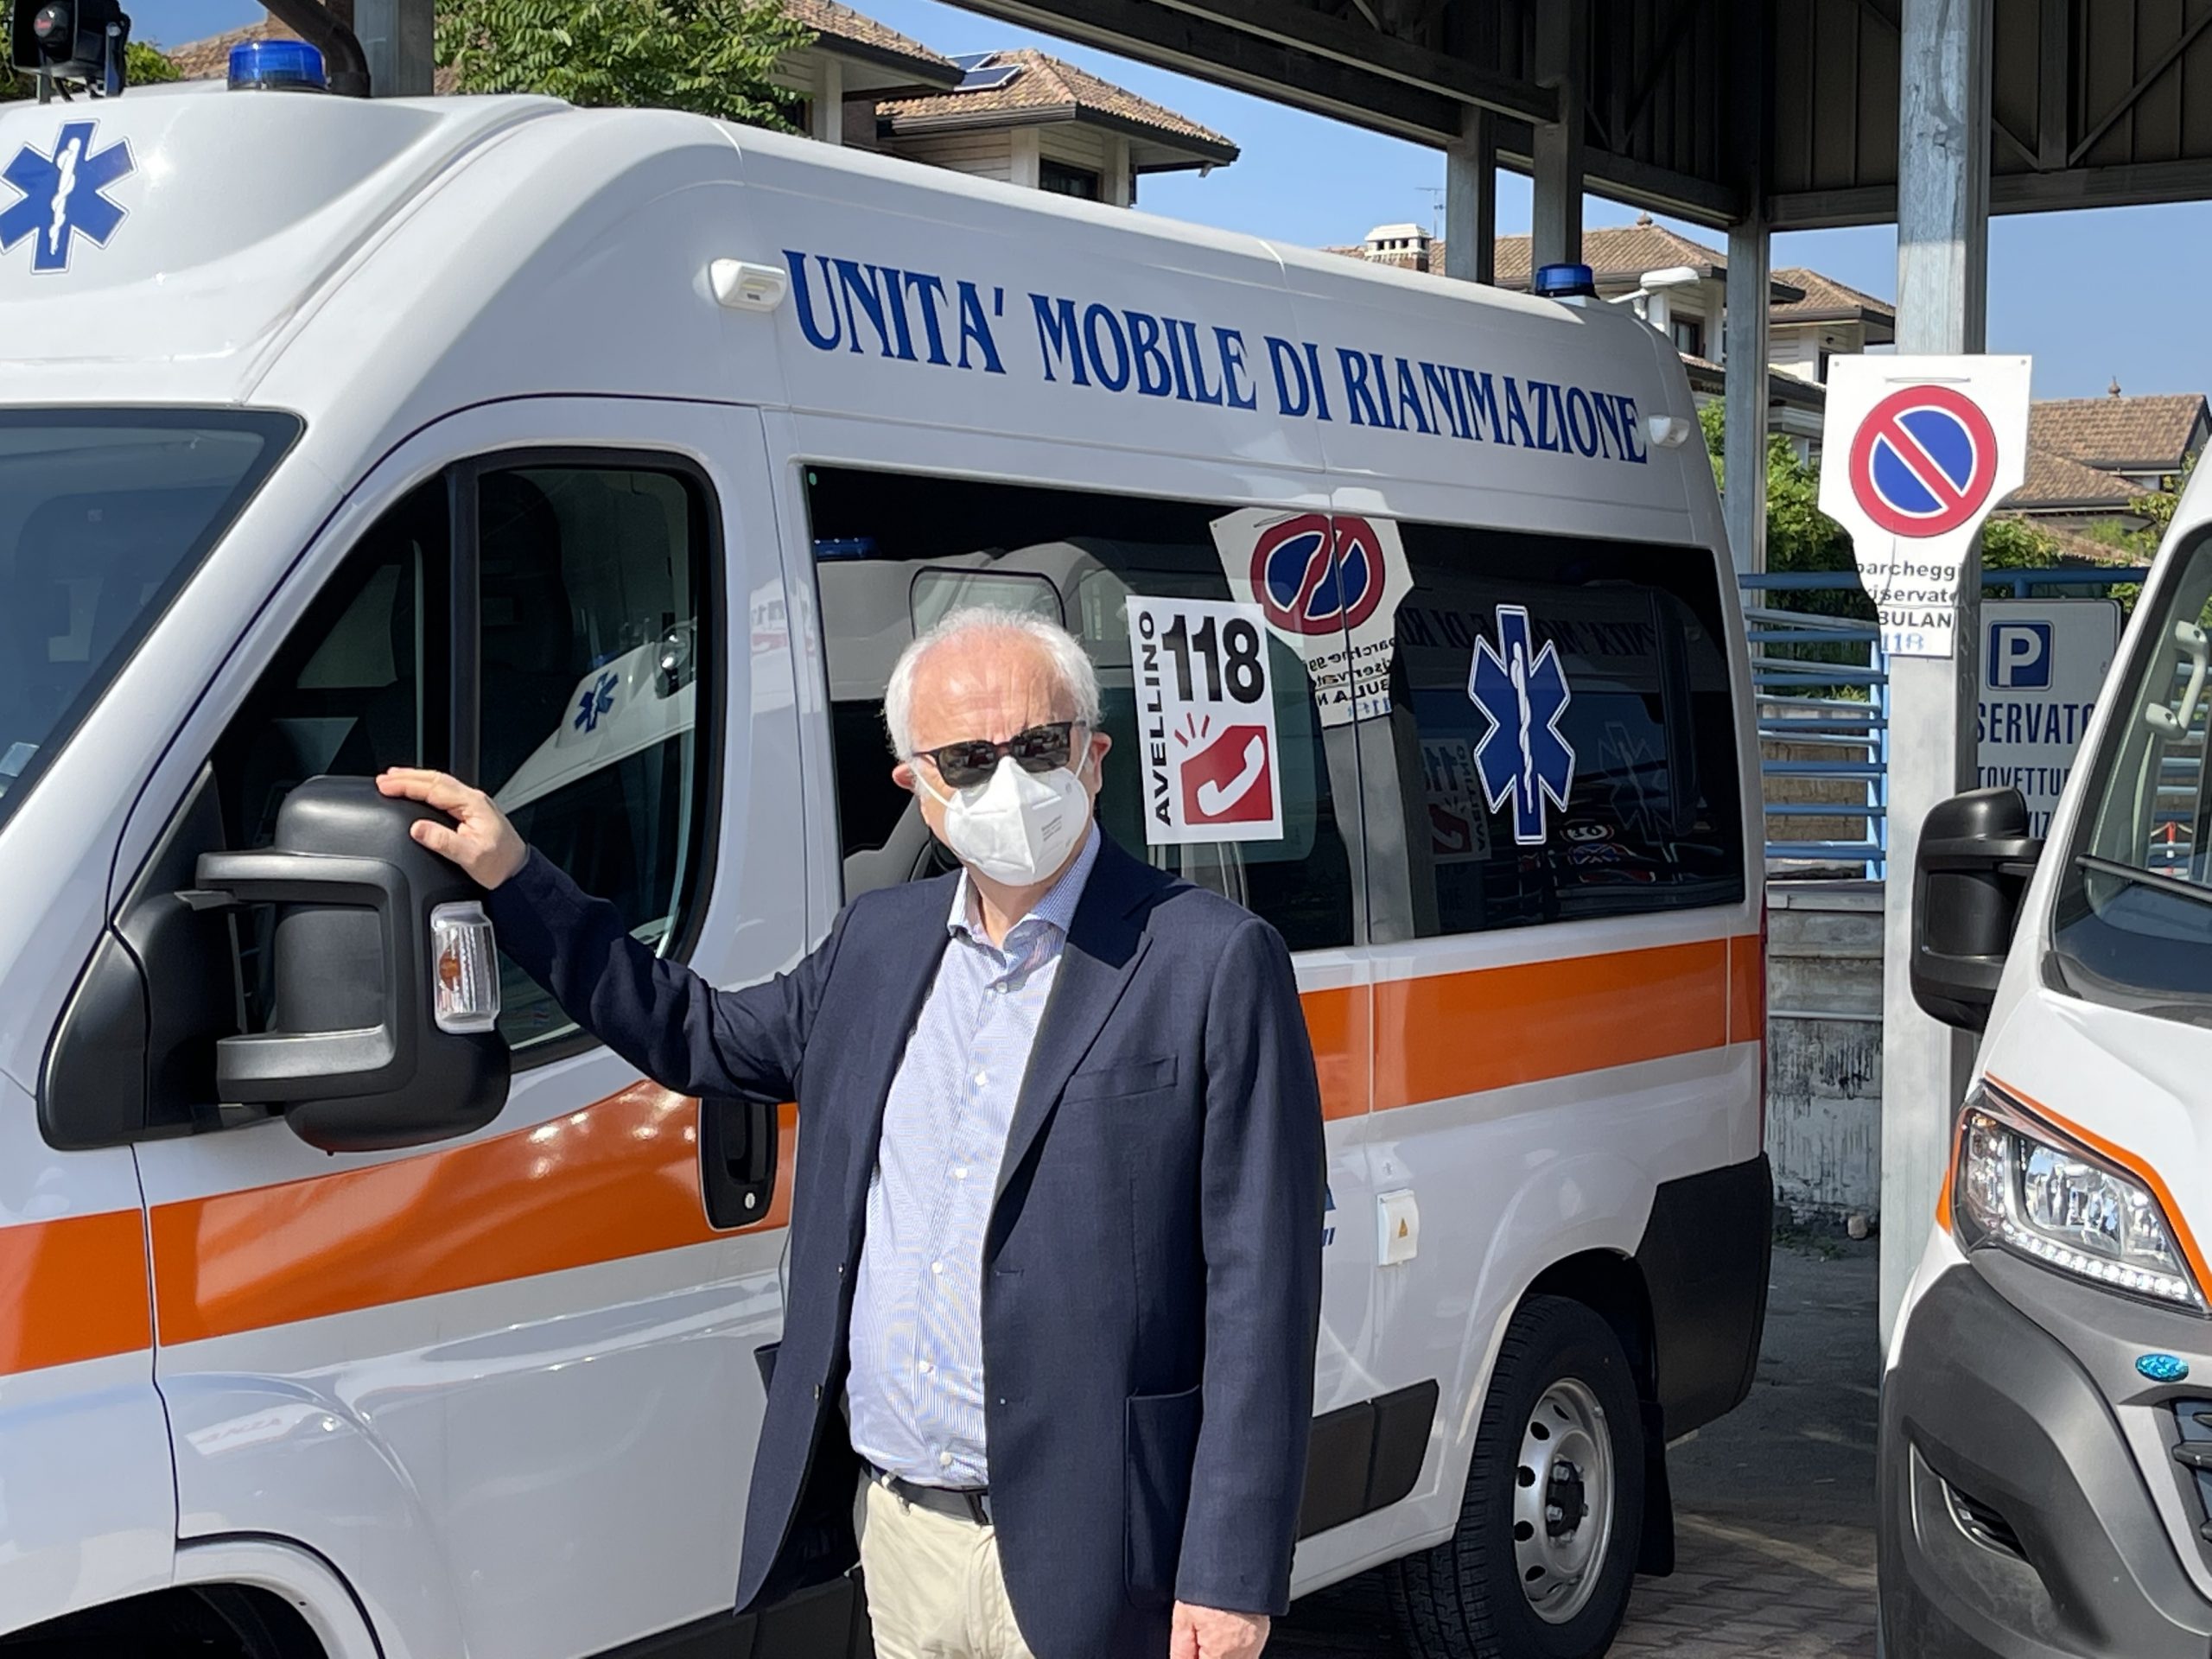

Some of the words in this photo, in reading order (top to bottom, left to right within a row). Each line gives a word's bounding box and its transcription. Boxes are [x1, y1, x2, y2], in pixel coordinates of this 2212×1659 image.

[782, 249, 1006, 374] UNITA'
[1028, 293, 1256, 410] MOBILE
[1263, 335, 1332, 421] DI
[1336, 347, 1648, 464] RIANIMAZIONE
[1139, 611, 1172, 827] AVELLINO
[1161, 614, 1265, 704] 118
[1998, 627, 2042, 685] P
